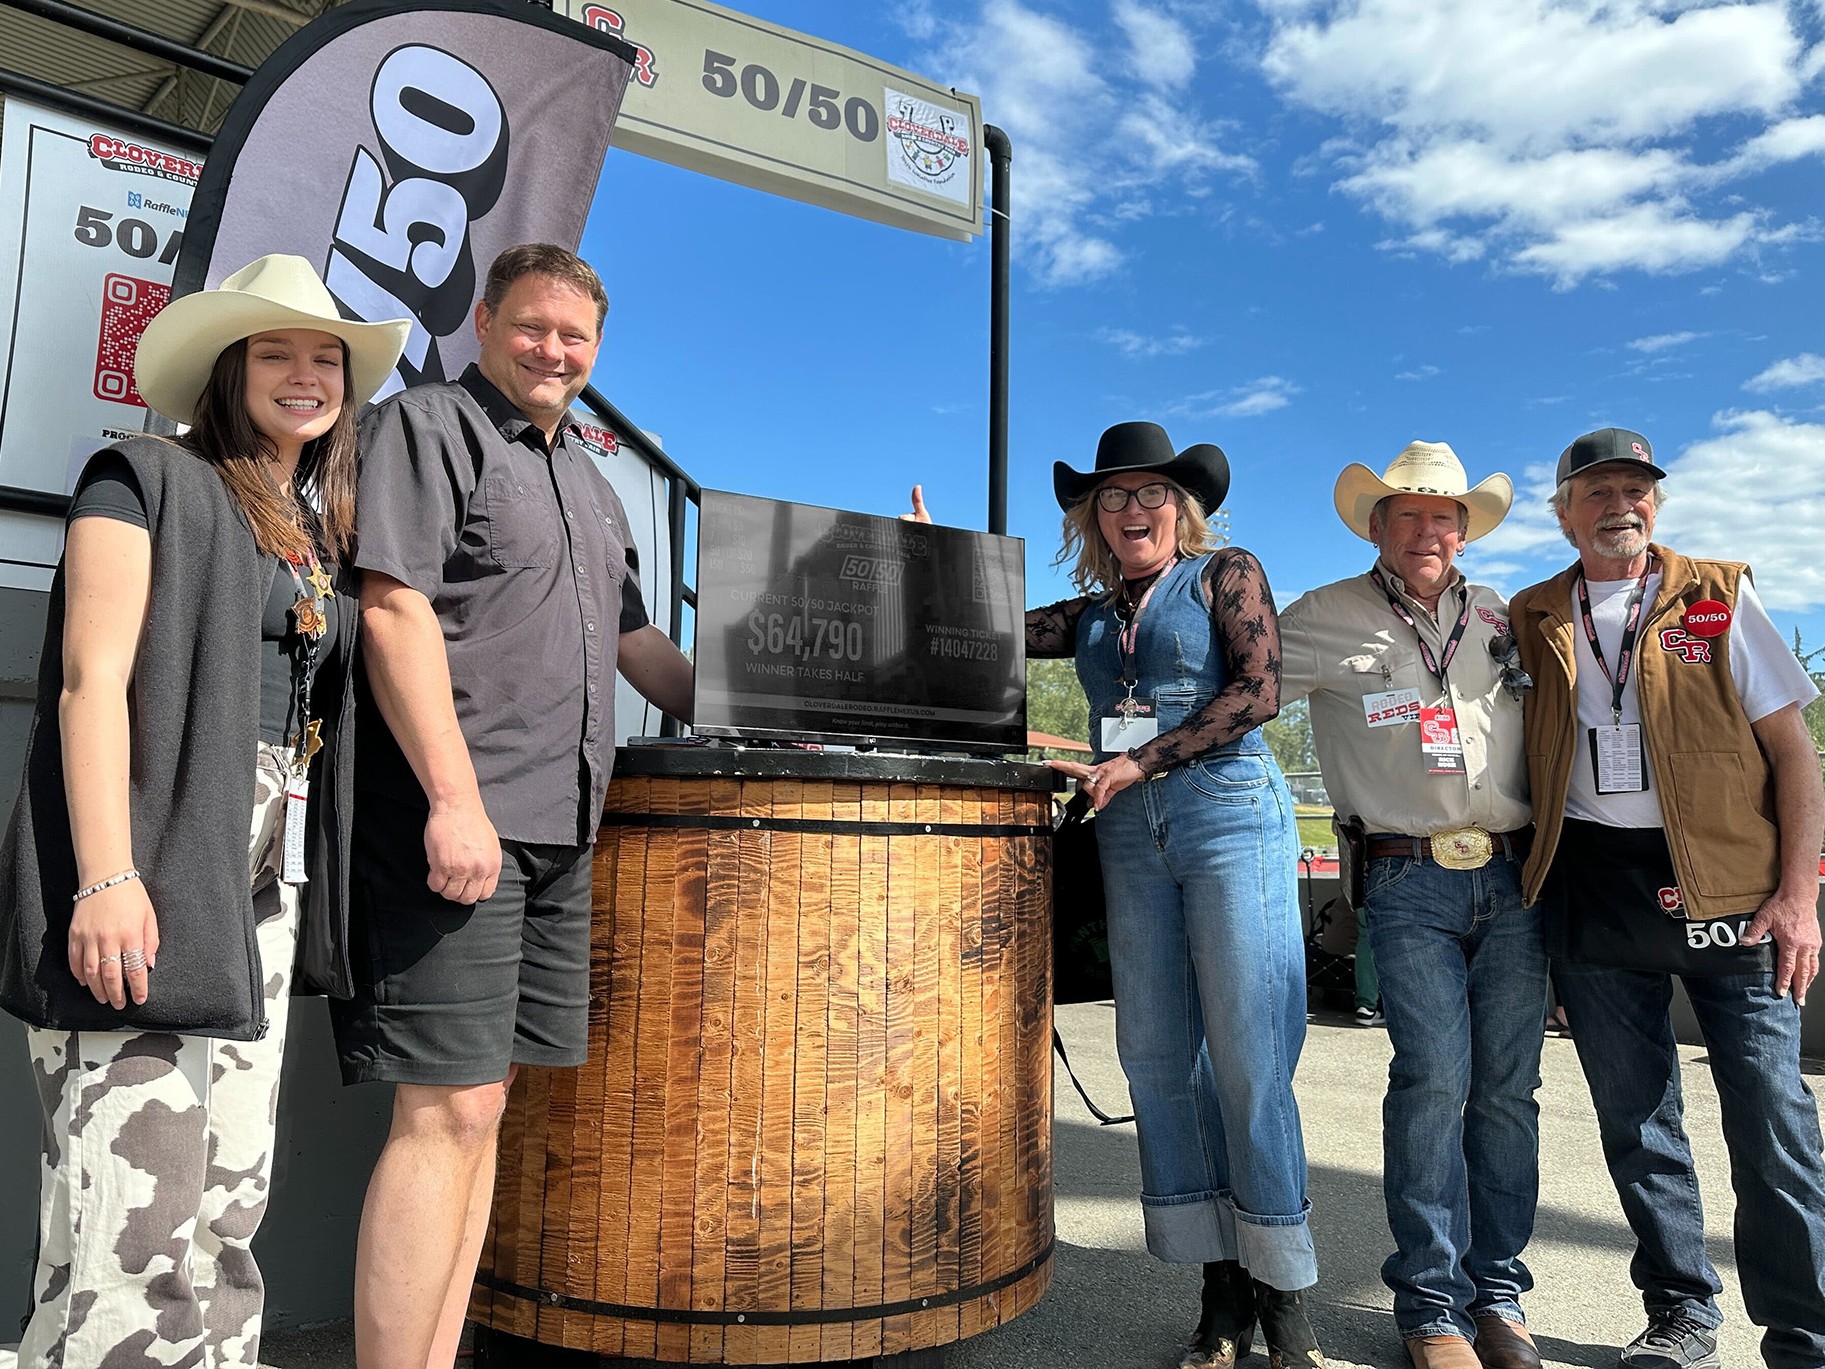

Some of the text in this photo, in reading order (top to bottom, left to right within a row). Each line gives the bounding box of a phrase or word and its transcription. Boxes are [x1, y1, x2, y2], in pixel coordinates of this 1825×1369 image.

[701, 48, 880, 143] 50/50
[888, 114, 968, 154] CLOVERDALE
[120, 163, 155, 175] RODEO
[156, 170, 164, 178] &
[325, 44, 508, 404] /50
[852, 581, 888, 593] RAFFLE
[730, 589, 880, 616] CURRENT 50/50 JACKPOT
[1688, 612, 1728, 624] 50/50
[747, 608, 863, 662] $64,790
[925, 624, 1001, 641] WINNING TICKET
[930, 637, 998, 661] #14047228
[1659, 628, 1712, 665] CR
[745, 662, 865, 682] WINNER TAKES HALF
[803, 701, 936, 716] CLOVERDALERODEO.RAFFLENEXUS.COM
[1367, 701, 1420, 723] REDS
[1371, 692, 1413, 711] RODEO
[1685, 920, 1773, 949] 50/
